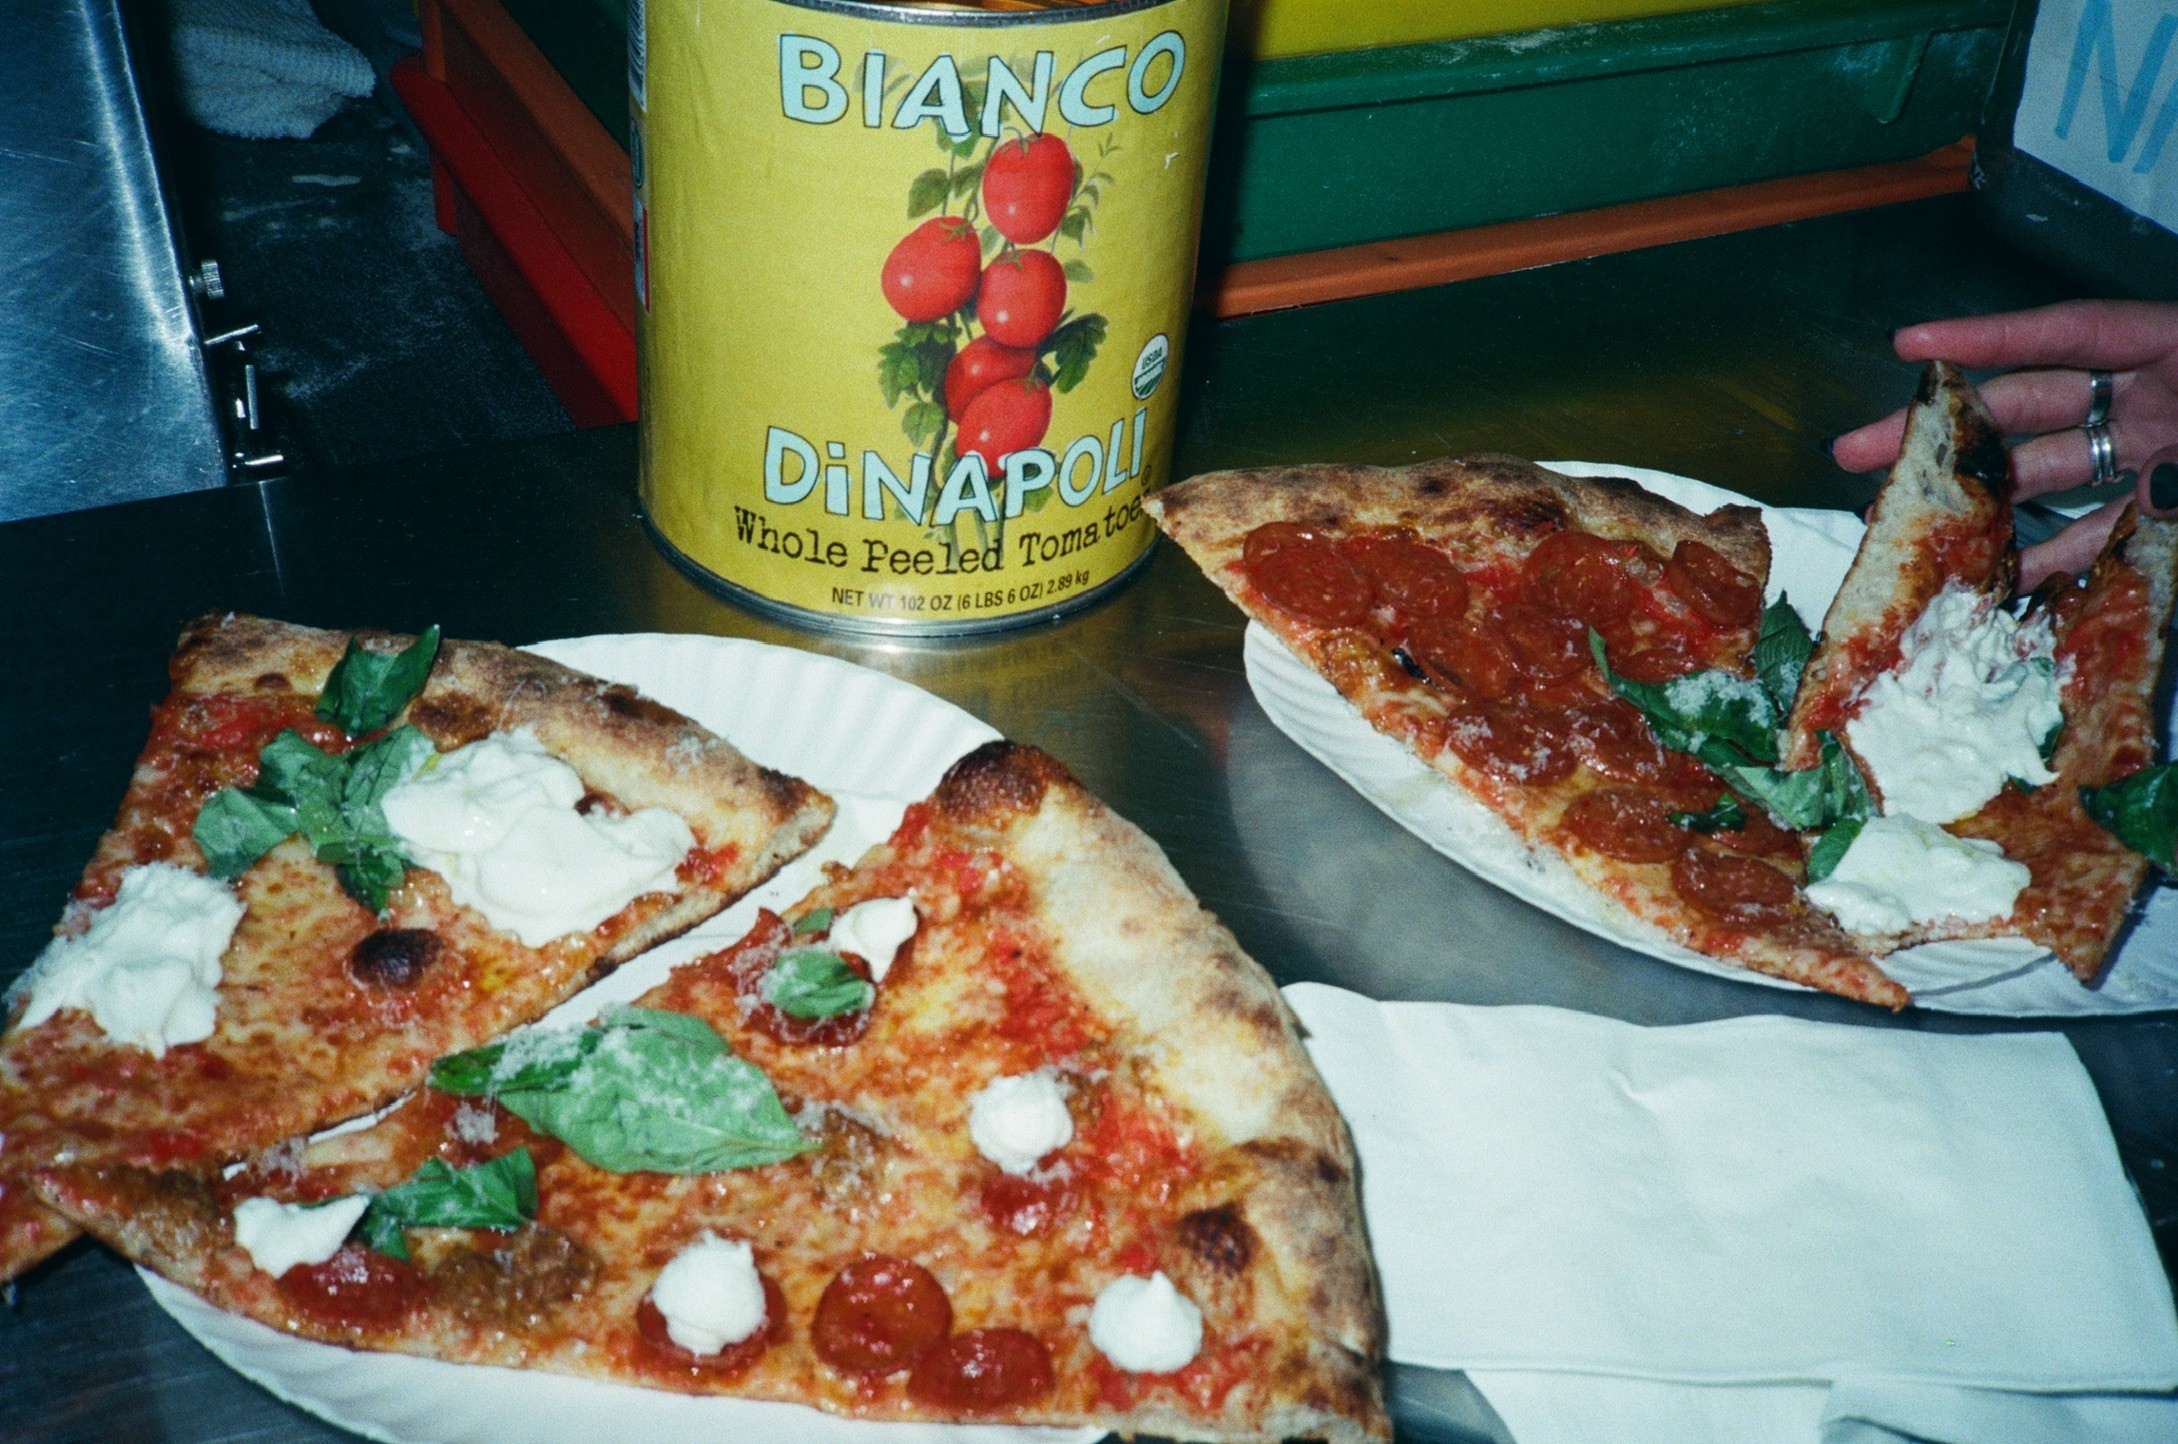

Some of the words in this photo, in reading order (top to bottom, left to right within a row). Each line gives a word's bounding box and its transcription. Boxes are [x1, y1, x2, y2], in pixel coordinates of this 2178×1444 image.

[778, 30, 1187, 140] BIANCO
[763, 407, 1148, 527] DiNAPOLI
[734, 505, 849, 568] Whole
[861, 537, 1004, 575] Peeled
[832, 587, 864, 607] NET
[868, 592, 896, 608] WT
[900, 594, 925, 611] 102
[930, 595, 953, 611] OZ
[957, 594, 971, 612] (6
[975, 590, 1003, 608] LBS
[1007, 588, 1016, 604] 6
[1019, 581, 1044, 602] OZ)
[1047, 573, 1072, 595] 2.89
[1075, 570, 1090, 586] kg
